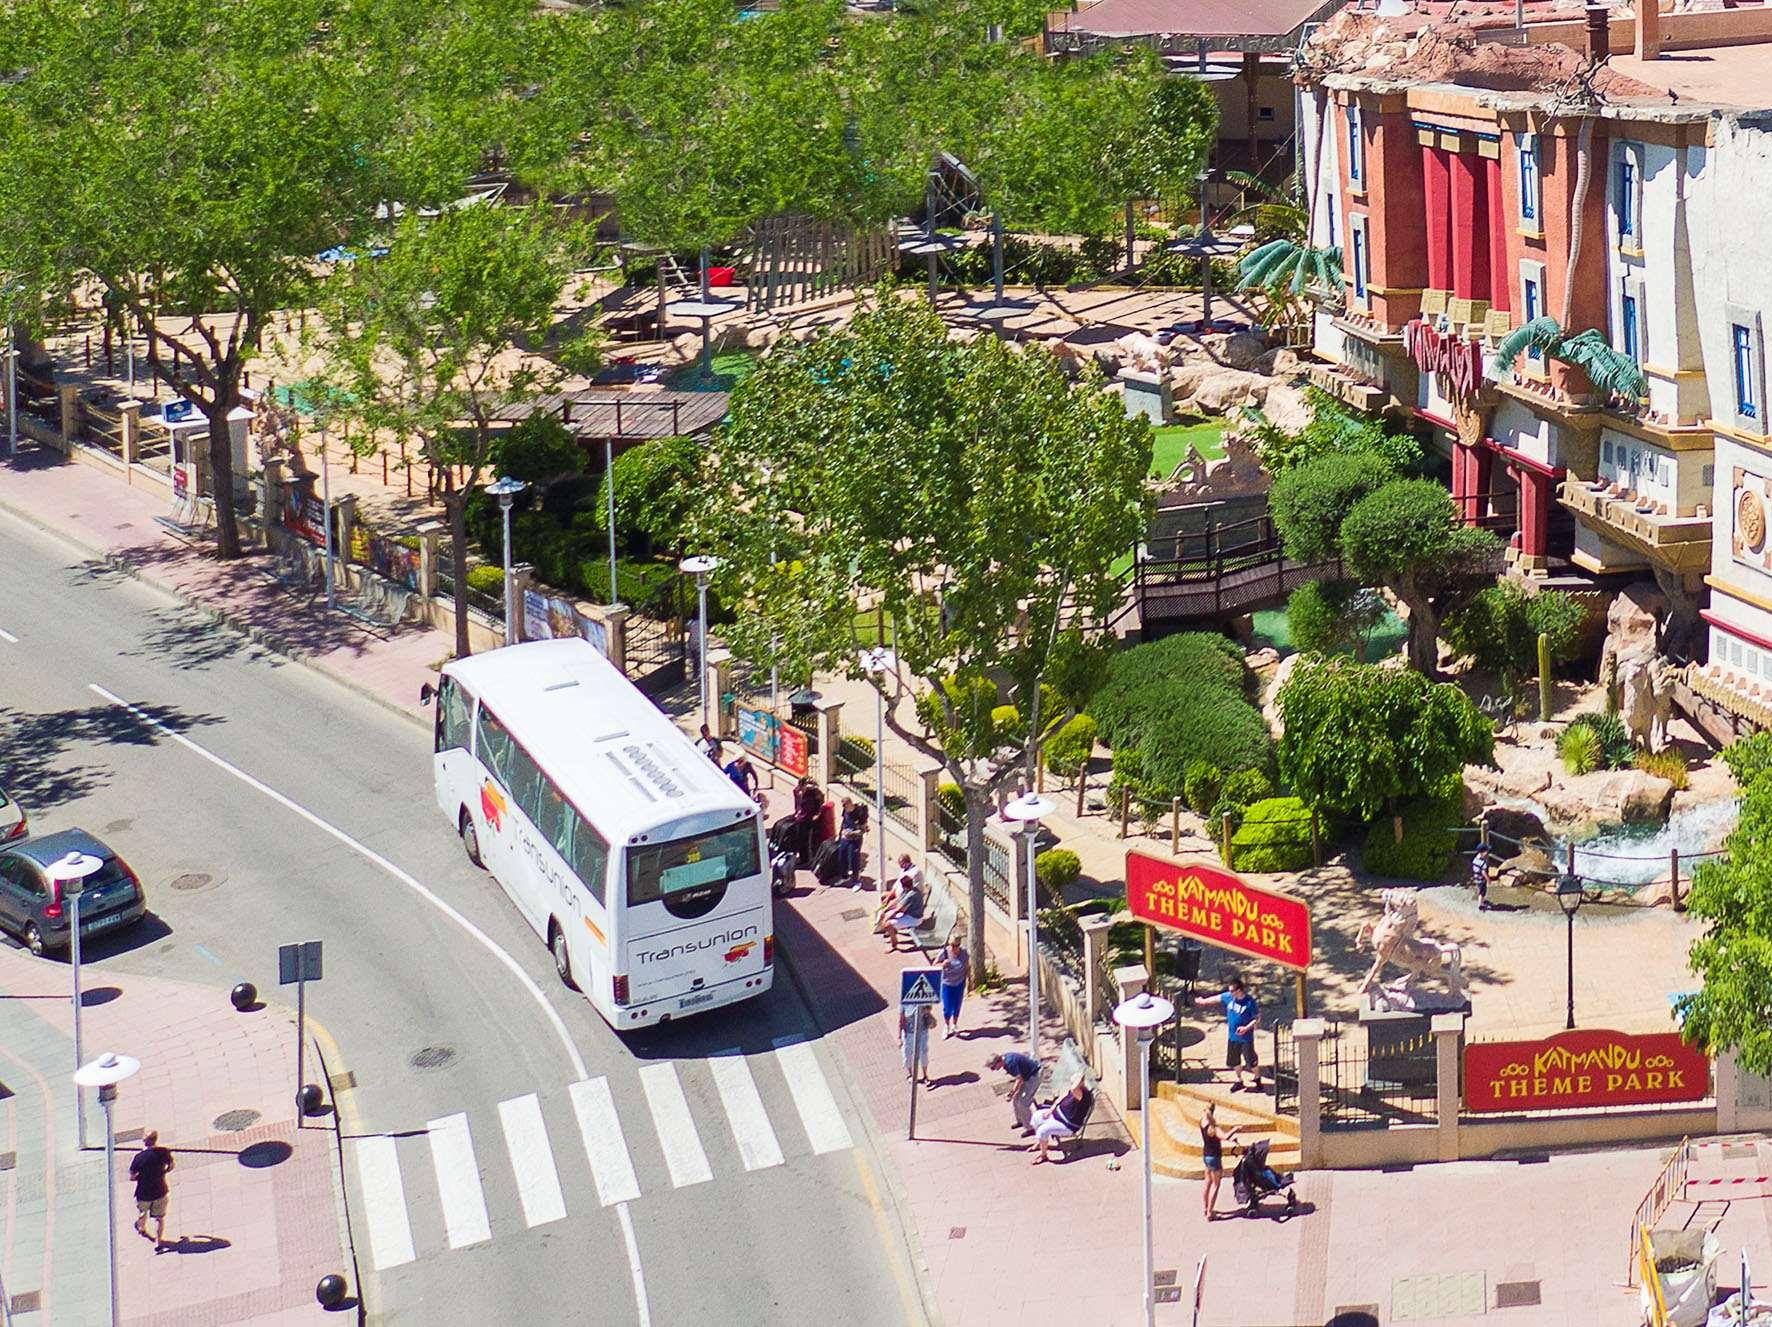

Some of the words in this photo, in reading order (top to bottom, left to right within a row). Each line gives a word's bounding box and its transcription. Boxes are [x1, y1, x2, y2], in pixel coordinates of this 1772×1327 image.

[1177, 875, 1259, 921] KATMANDU
[1145, 892, 1223, 931] THEME
[1232, 919, 1293, 954] PARK
[1533, 1043, 1641, 1077] KATMANDU
[1489, 1075, 1592, 1098] THEME
[1606, 1070, 1685, 1092] PARK
